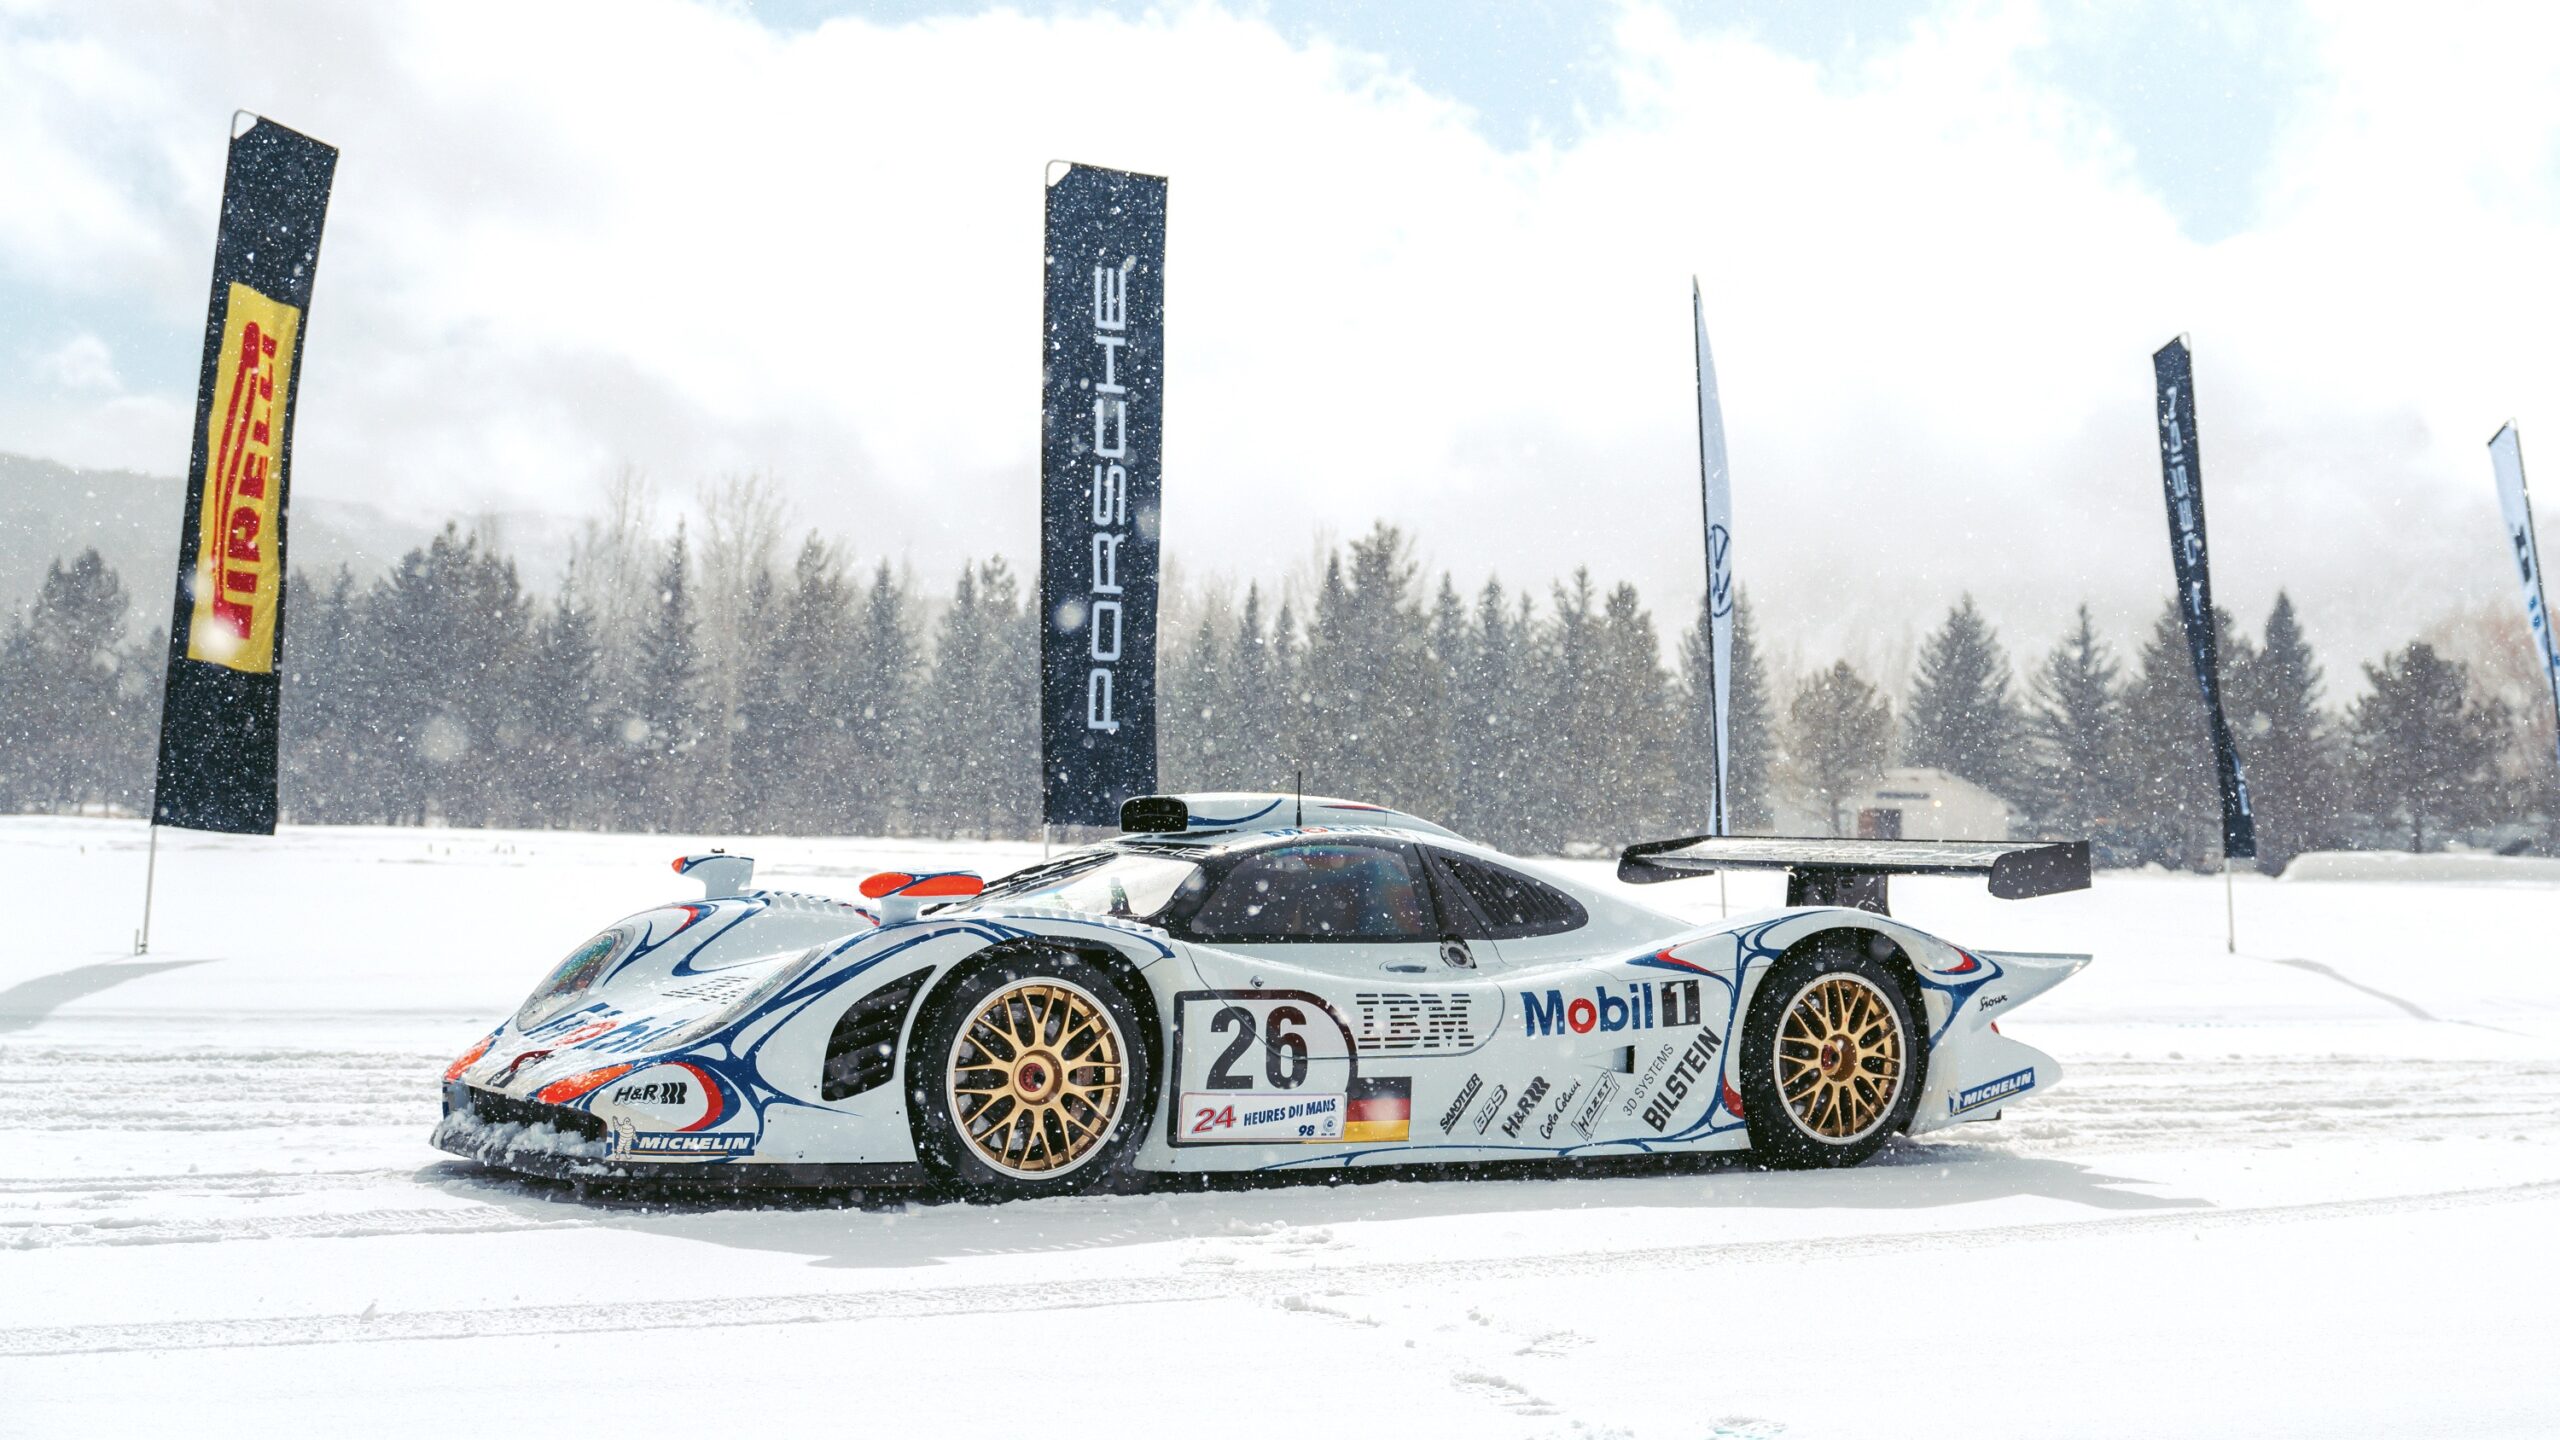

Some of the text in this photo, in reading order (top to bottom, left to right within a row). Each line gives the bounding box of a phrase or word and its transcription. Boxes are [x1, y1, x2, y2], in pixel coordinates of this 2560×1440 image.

[211, 320, 279, 640] PIRELLI
[1087, 264, 1129, 732] PORSCHE
[1356, 993, 1475, 1049] IBM
[1519, 982, 1655, 1038] Mobil
[1206, 1006, 1308, 1090] 26
[614, 1083, 660, 1104] H&R
[1440, 1073, 1482, 1131] SANDTLER
[1578, 1080, 1611, 1132] HAZET
[1622, 1043, 1674, 1117] 3D SYSTEMS
[1642, 1025, 1723, 1133] BILSTEIN
[1963, 1072, 2032, 1107] MICHELIN
[1192, 1104, 1237, 1135] 24
[1243, 1107, 1286, 1127] HEURES
[1306, 1098, 1337, 1116] MANS
[1298, 1124, 1316, 1137] 98
[1474, 1084, 1507, 1135] BBS
[638, 1137, 751, 1150] MICHELIN
